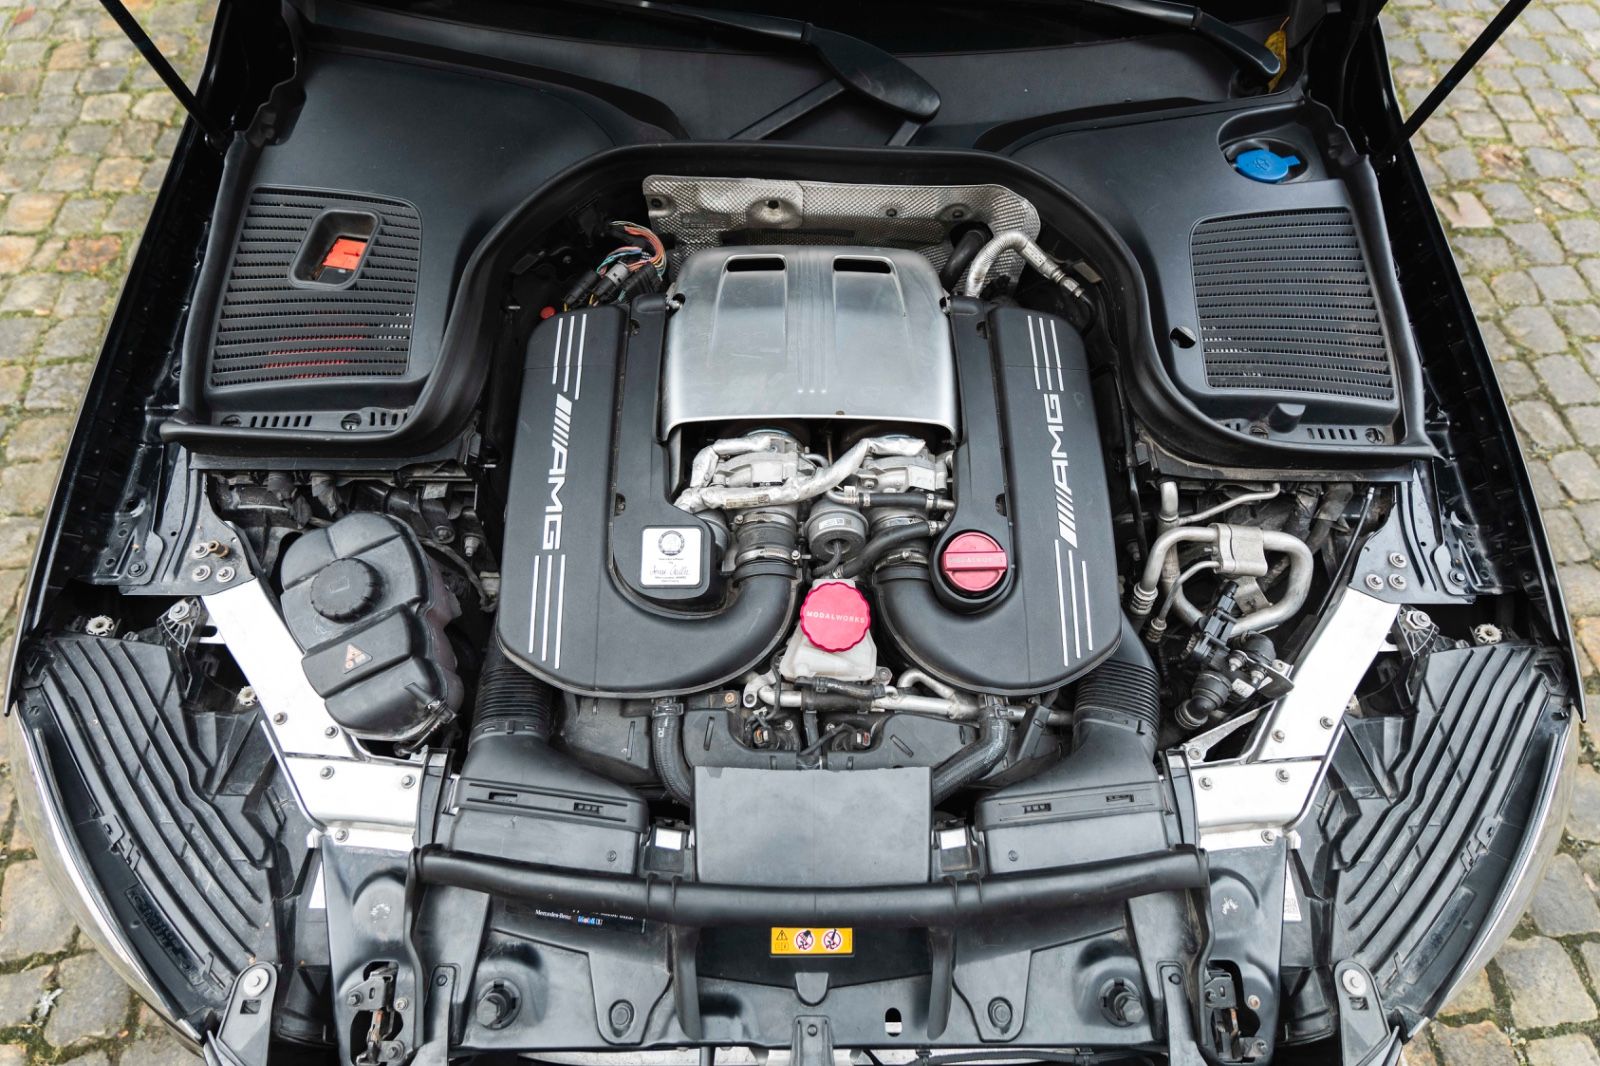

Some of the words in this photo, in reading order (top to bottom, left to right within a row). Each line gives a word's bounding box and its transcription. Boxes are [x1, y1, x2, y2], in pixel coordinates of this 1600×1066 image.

[1044, 393, 1073, 496] AMG
[542, 442, 568, 550] AMG
[806, 611, 865, 623] MODALWORKS
[535, 909, 572, 920] Mercedes-Benz
